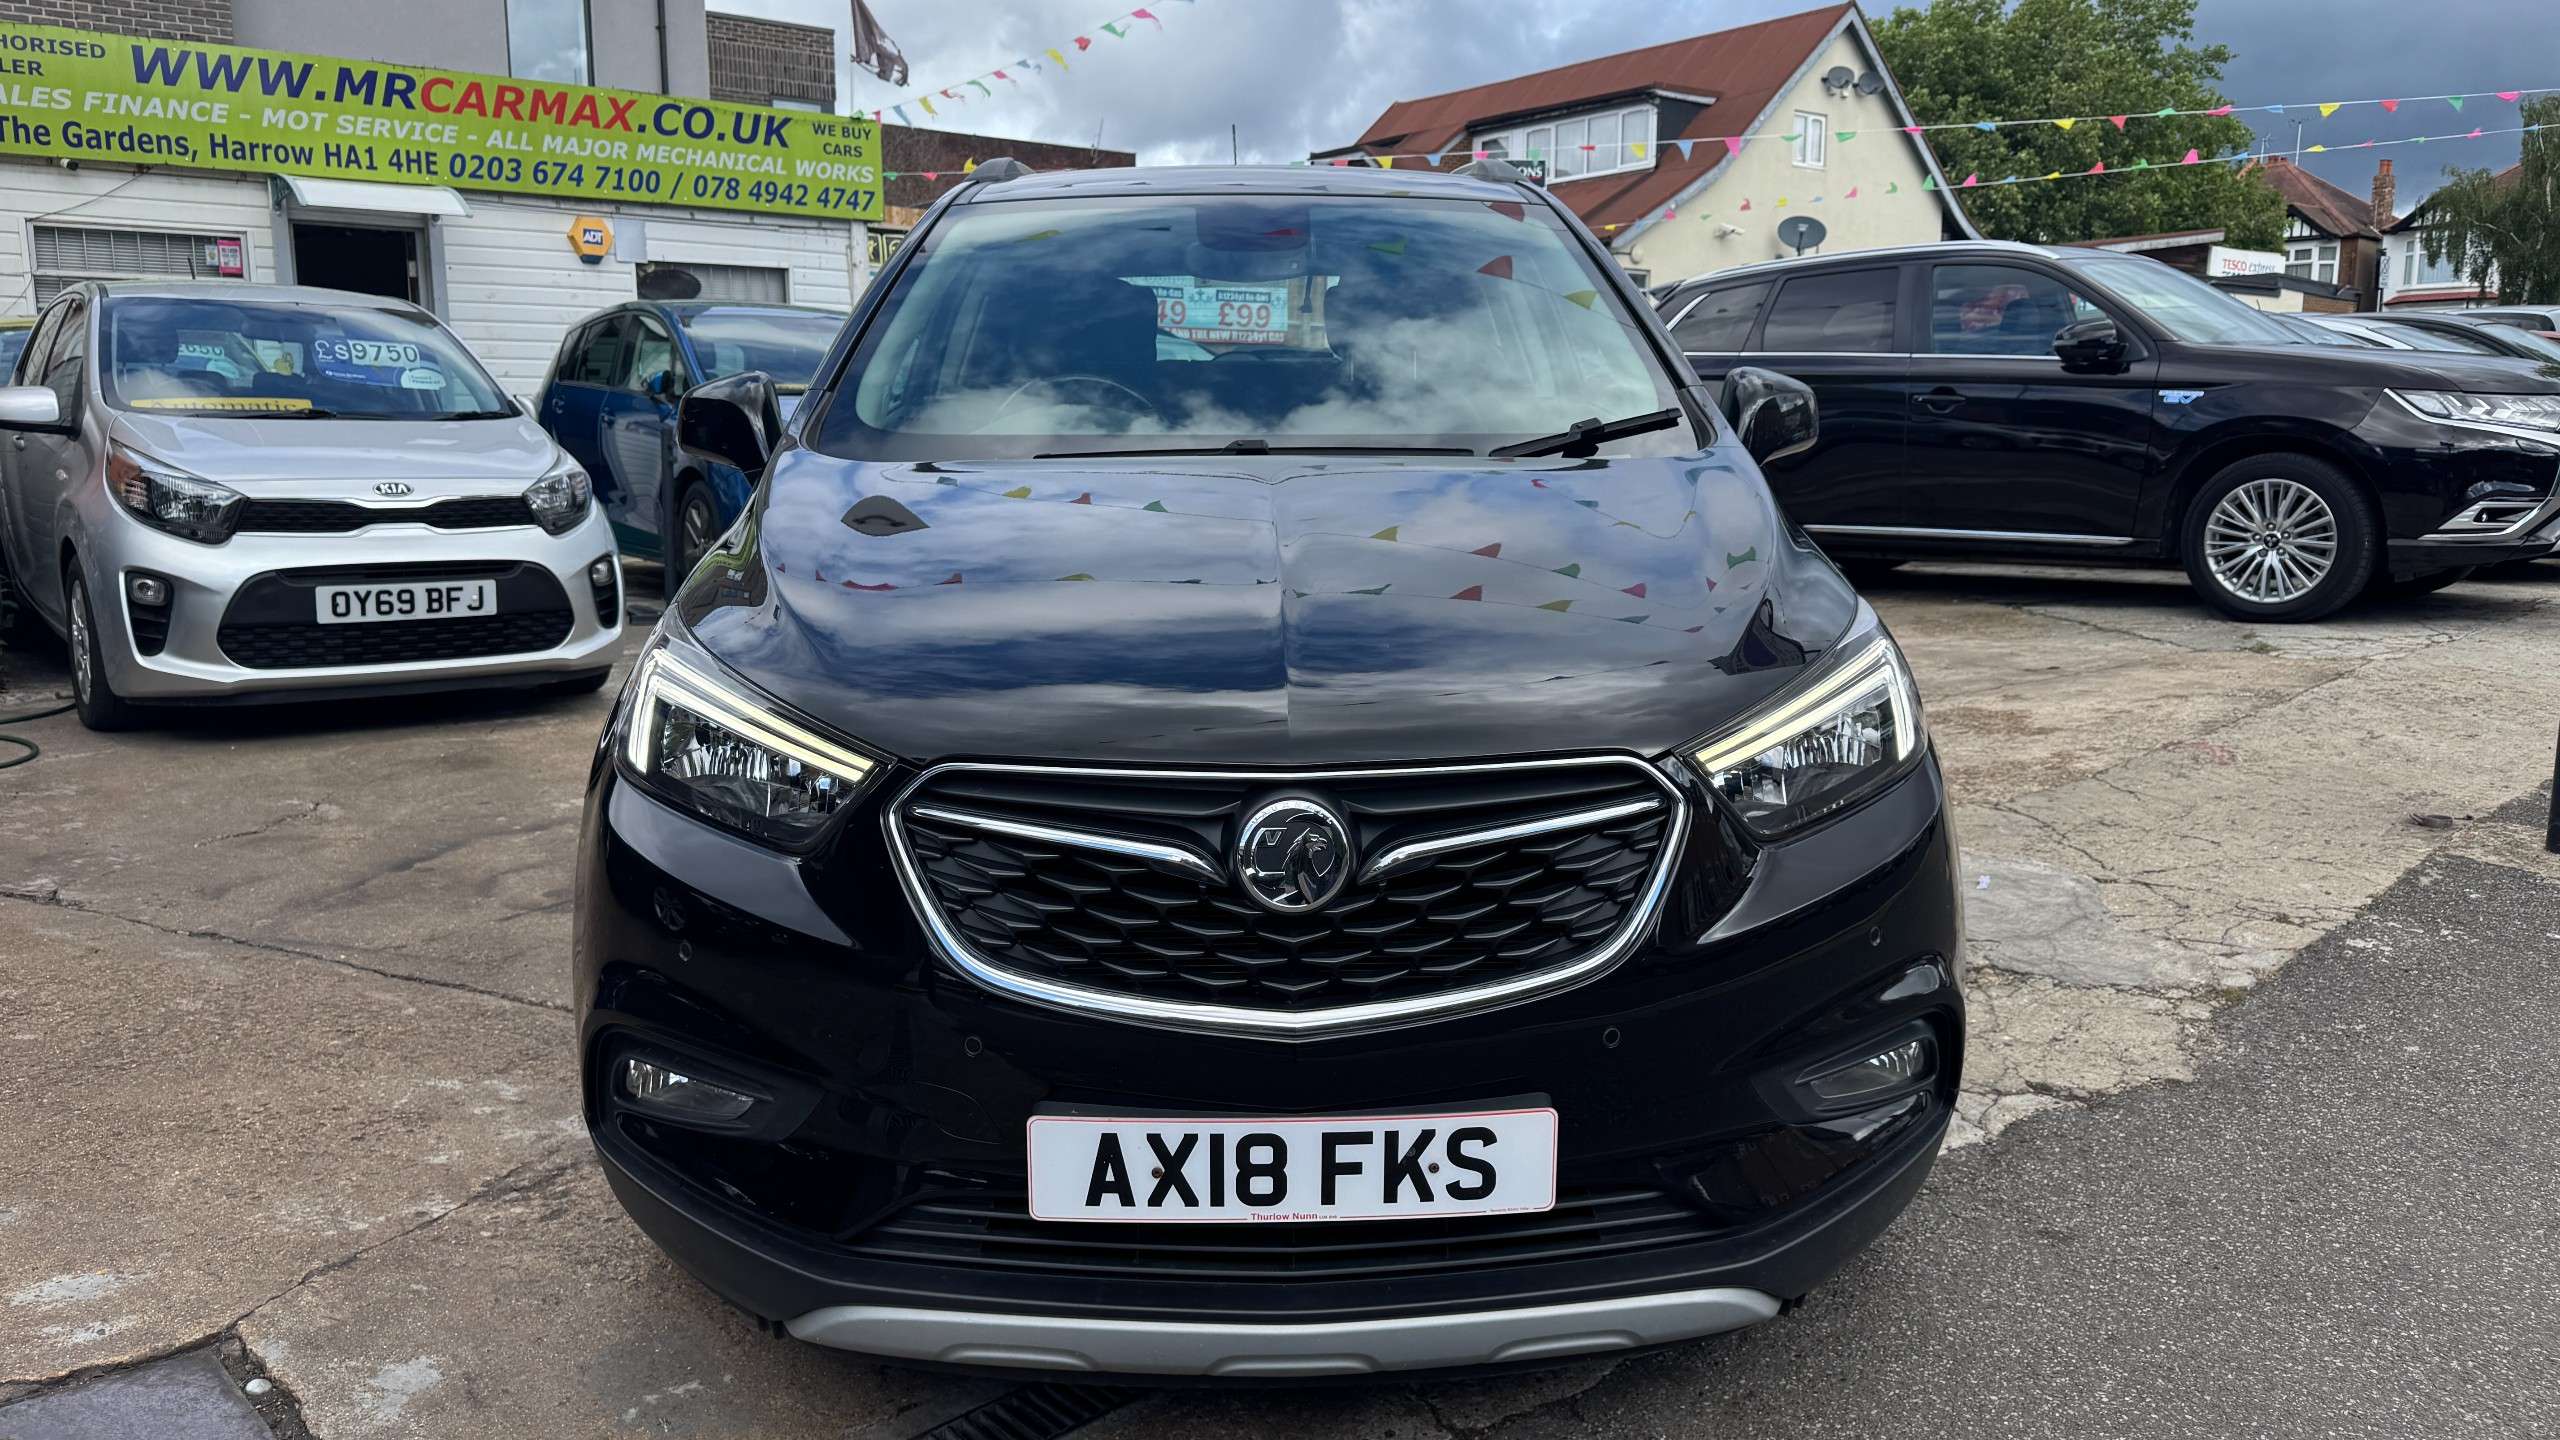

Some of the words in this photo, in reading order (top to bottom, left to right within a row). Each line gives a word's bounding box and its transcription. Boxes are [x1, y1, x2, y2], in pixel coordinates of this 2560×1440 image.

[83, 91, 229, 124] FINANCE
[262, 107, 328, 132] MOT
[336, 114, 458, 144] SERVICE
[485, 130, 534, 151] ALL
[542, 134, 629, 160] MAJOR
[636, 144, 788, 175] MECHANICAL
[795, 160, 875, 183] WORKS
[812, 123, 836, 137] WE
[841, 125, 872, 141] BUY
[823, 142, 863, 158] CARS
[0, 115, 52, 146] The
[62, 120, 198, 163] Gardens,
[209, 132, 313, 166] Harrow
[324, 142, 378, 171] HA1
[388, 148, 438, 176] 4HE
[449, 152, 522, 183] 0203
[532, 160, 584, 187] 674
[595, 166, 661, 193] 7100
[693, 174, 740, 200] 078
[748, 180, 809, 207] 4942
[816, 186, 876, 212] 4747
[584, 230, 603, 244] ADT
[2223, 258, 2248, 272] TESCO
[1218, 301, 1271, 329] £99
[380, 483, 409, 495] KIA
[331, 589, 415, 618] OY69
[425, 585, 484, 614] BFJ
[1085, 1132, 1288, 1208] AX18
[1320, 1126, 1498, 1206] FKS
[1251, 1212, 1289, 1221] Thurlow
[1292, 1212, 1318, 1221] Nunn
